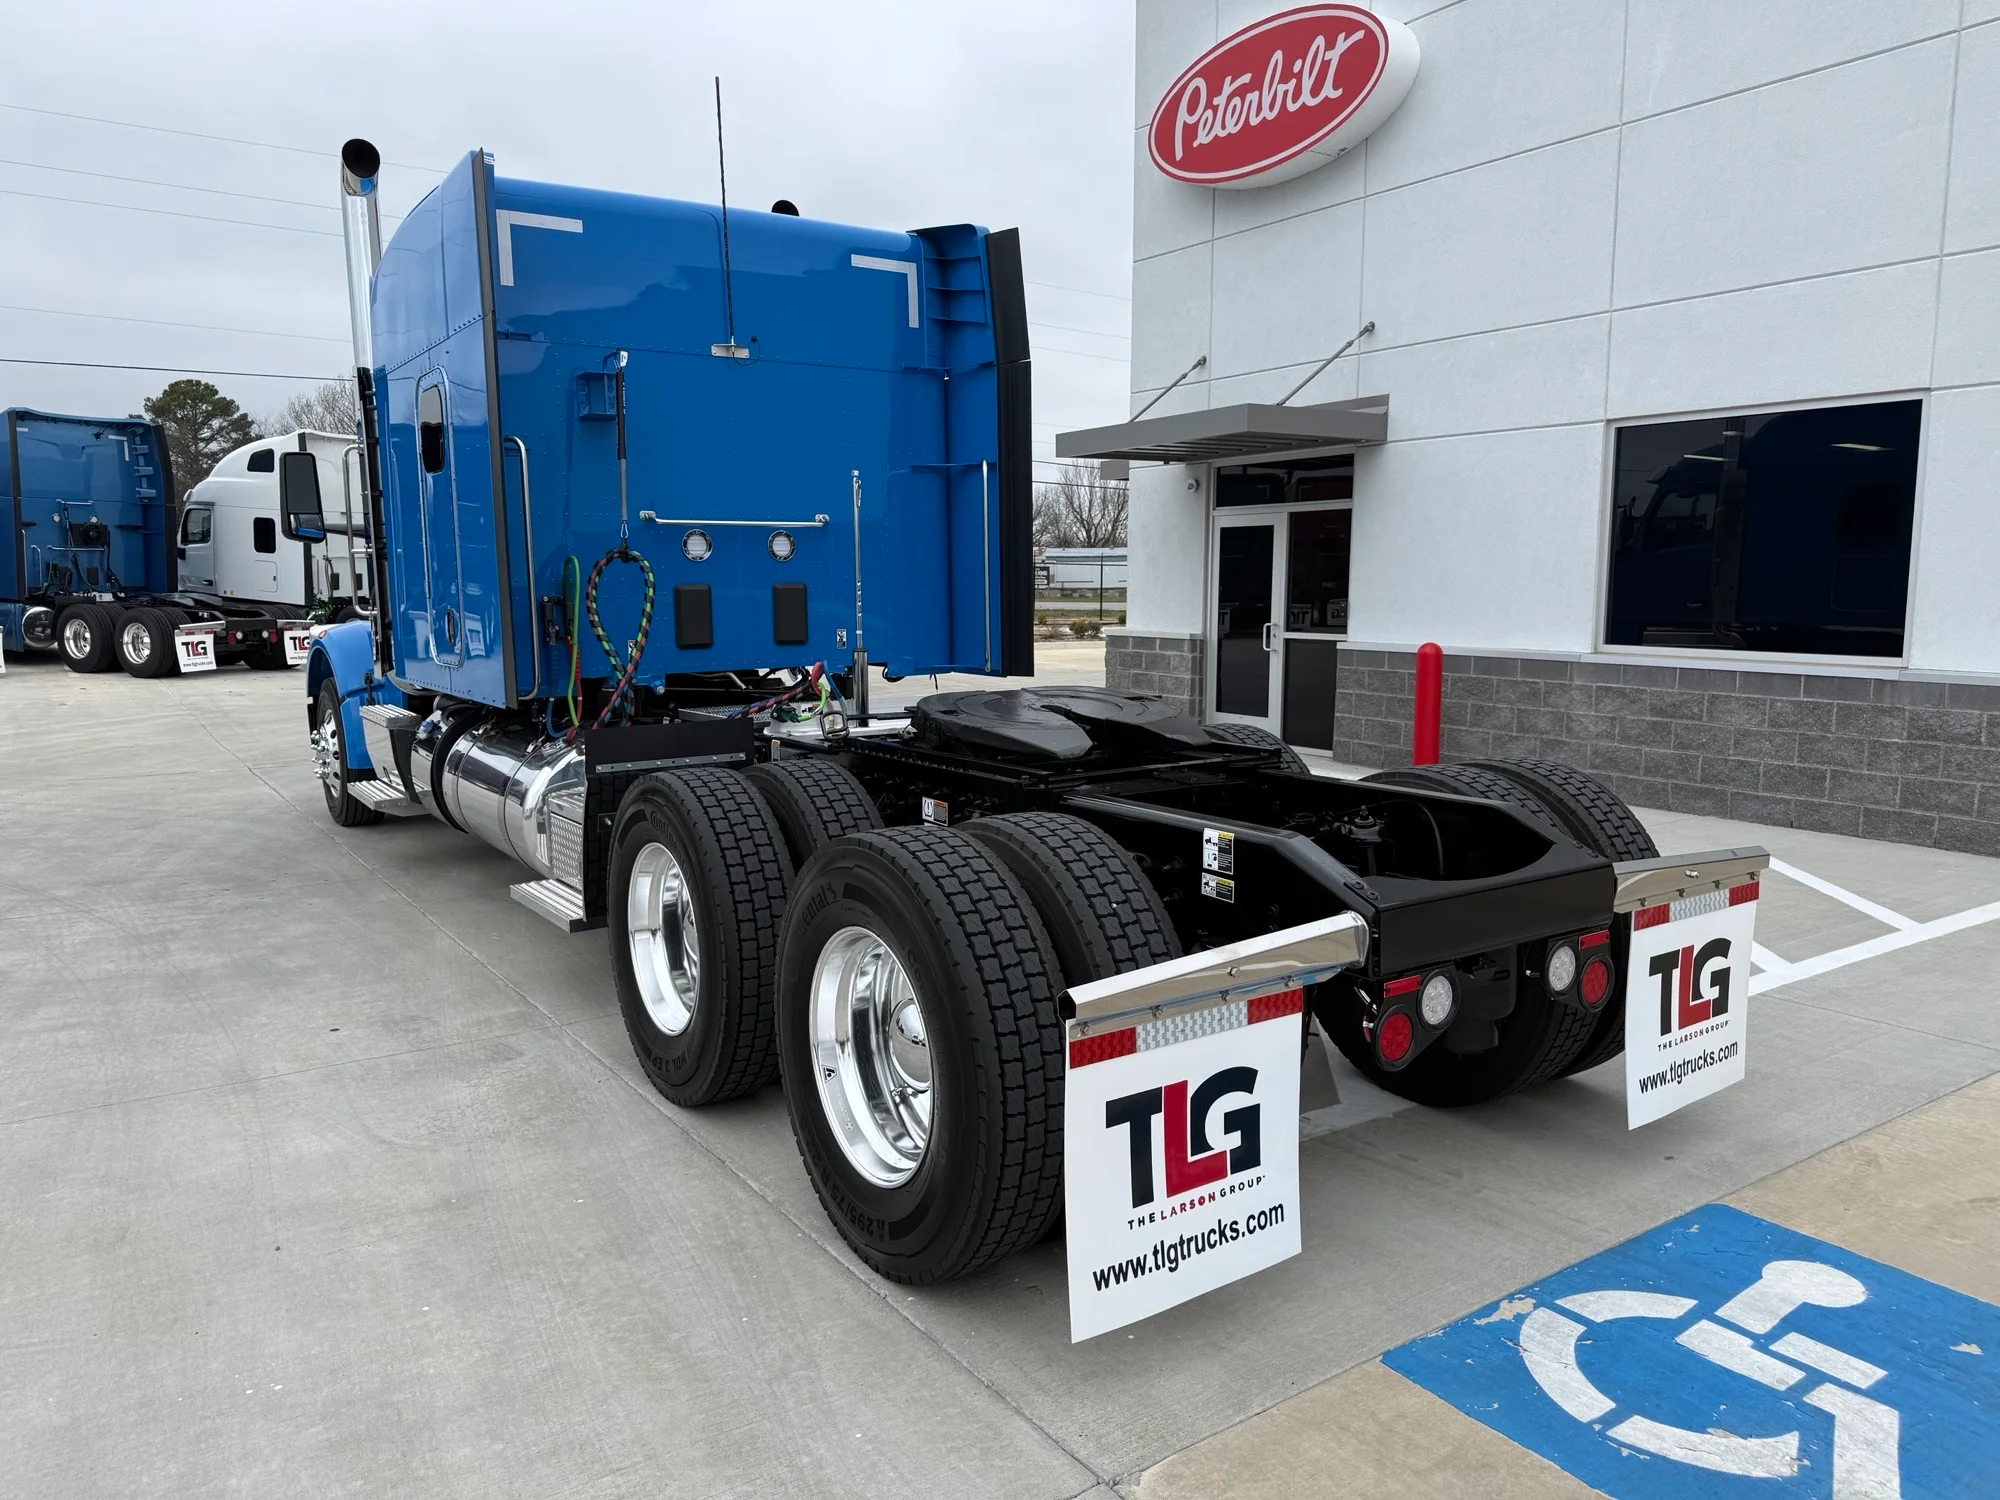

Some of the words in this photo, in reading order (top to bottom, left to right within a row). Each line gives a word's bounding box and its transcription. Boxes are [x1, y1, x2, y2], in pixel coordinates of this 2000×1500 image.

[1174, 29, 1366, 162] Peterbilt
[180, 640, 208, 658] TLG
[1648, 937, 1732, 1037] TLG
[1638, 1041, 1739, 1094] www.tlgtrucks.com
[1657, 1040, 1673, 1052] THE
[1674, 1029, 1704, 1046] LARSON
[1705, 1020, 1729, 1034] GROUP
[1105, 1066, 1262, 1209] TLG
[1127, 1212, 1156, 1230] THE
[1160, 1192, 1216, 1221] LARSON
[1219, 1176, 1263, 1198] GROUP
[1092, 1203, 1285, 1292] www.tlgtrucks.com
